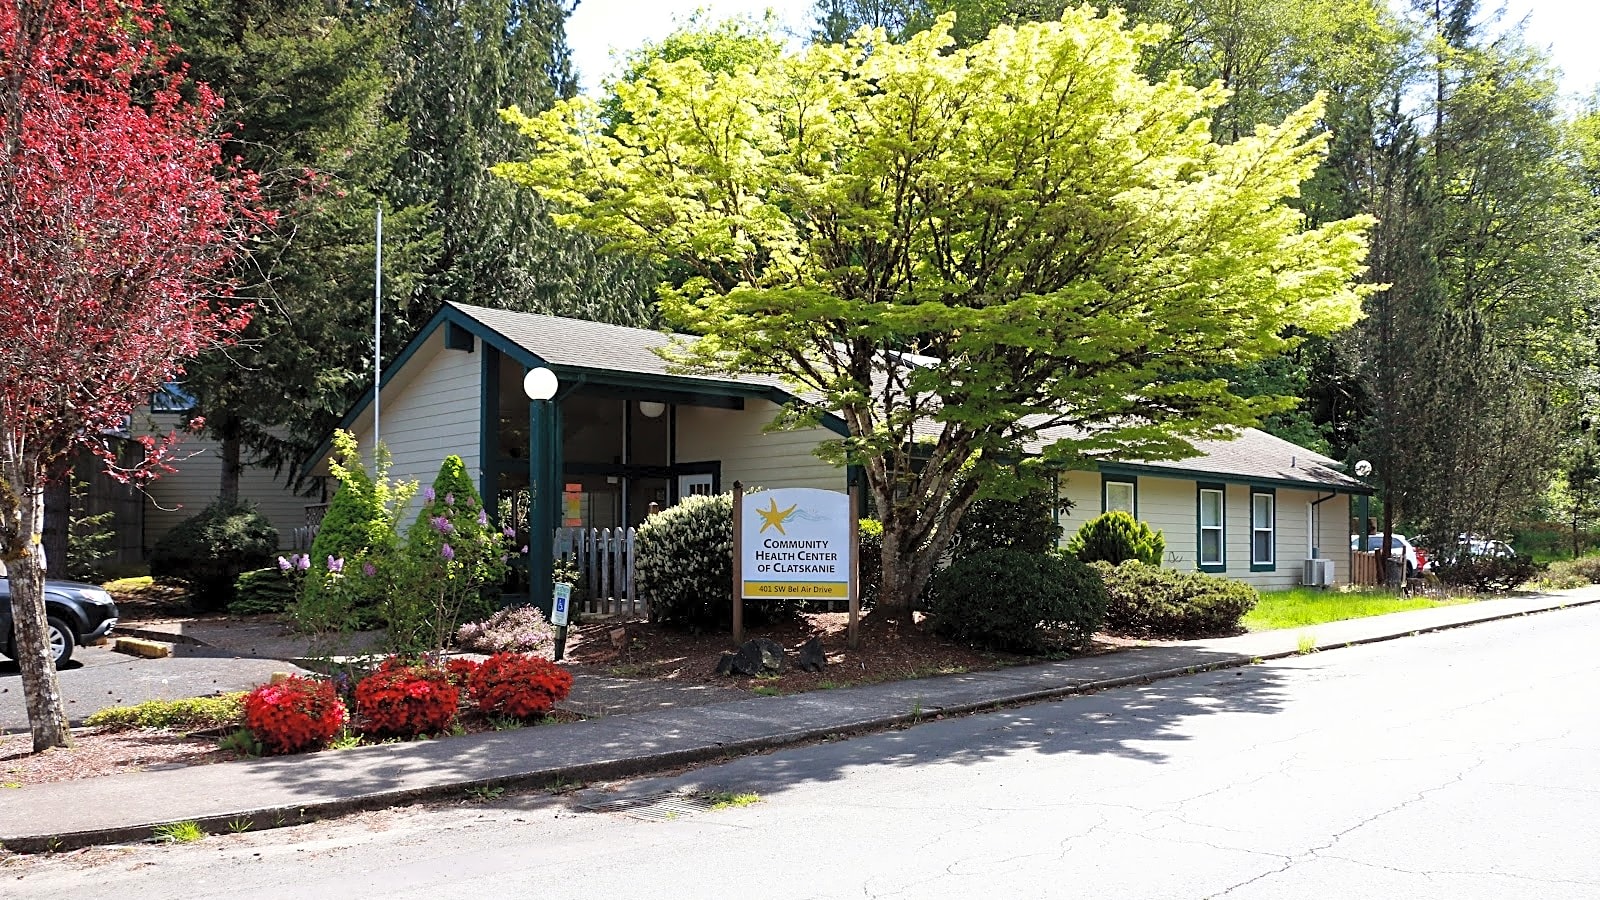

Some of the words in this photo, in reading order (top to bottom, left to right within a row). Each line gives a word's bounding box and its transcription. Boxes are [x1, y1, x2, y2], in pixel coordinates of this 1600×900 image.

[763, 538, 829, 549] COMMUNITY
[755, 550, 795, 561] HEALTH
[797, 550, 838, 561] CENTER
[757, 564, 771, 573] OF
[773, 562, 835, 573] CLATSKANIE
[758, 585, 772, 593] 401
[774, 585, 786, 593] SW
[787, 585, 799, 593] Bel
[813, 586, 833, 594] Drive
